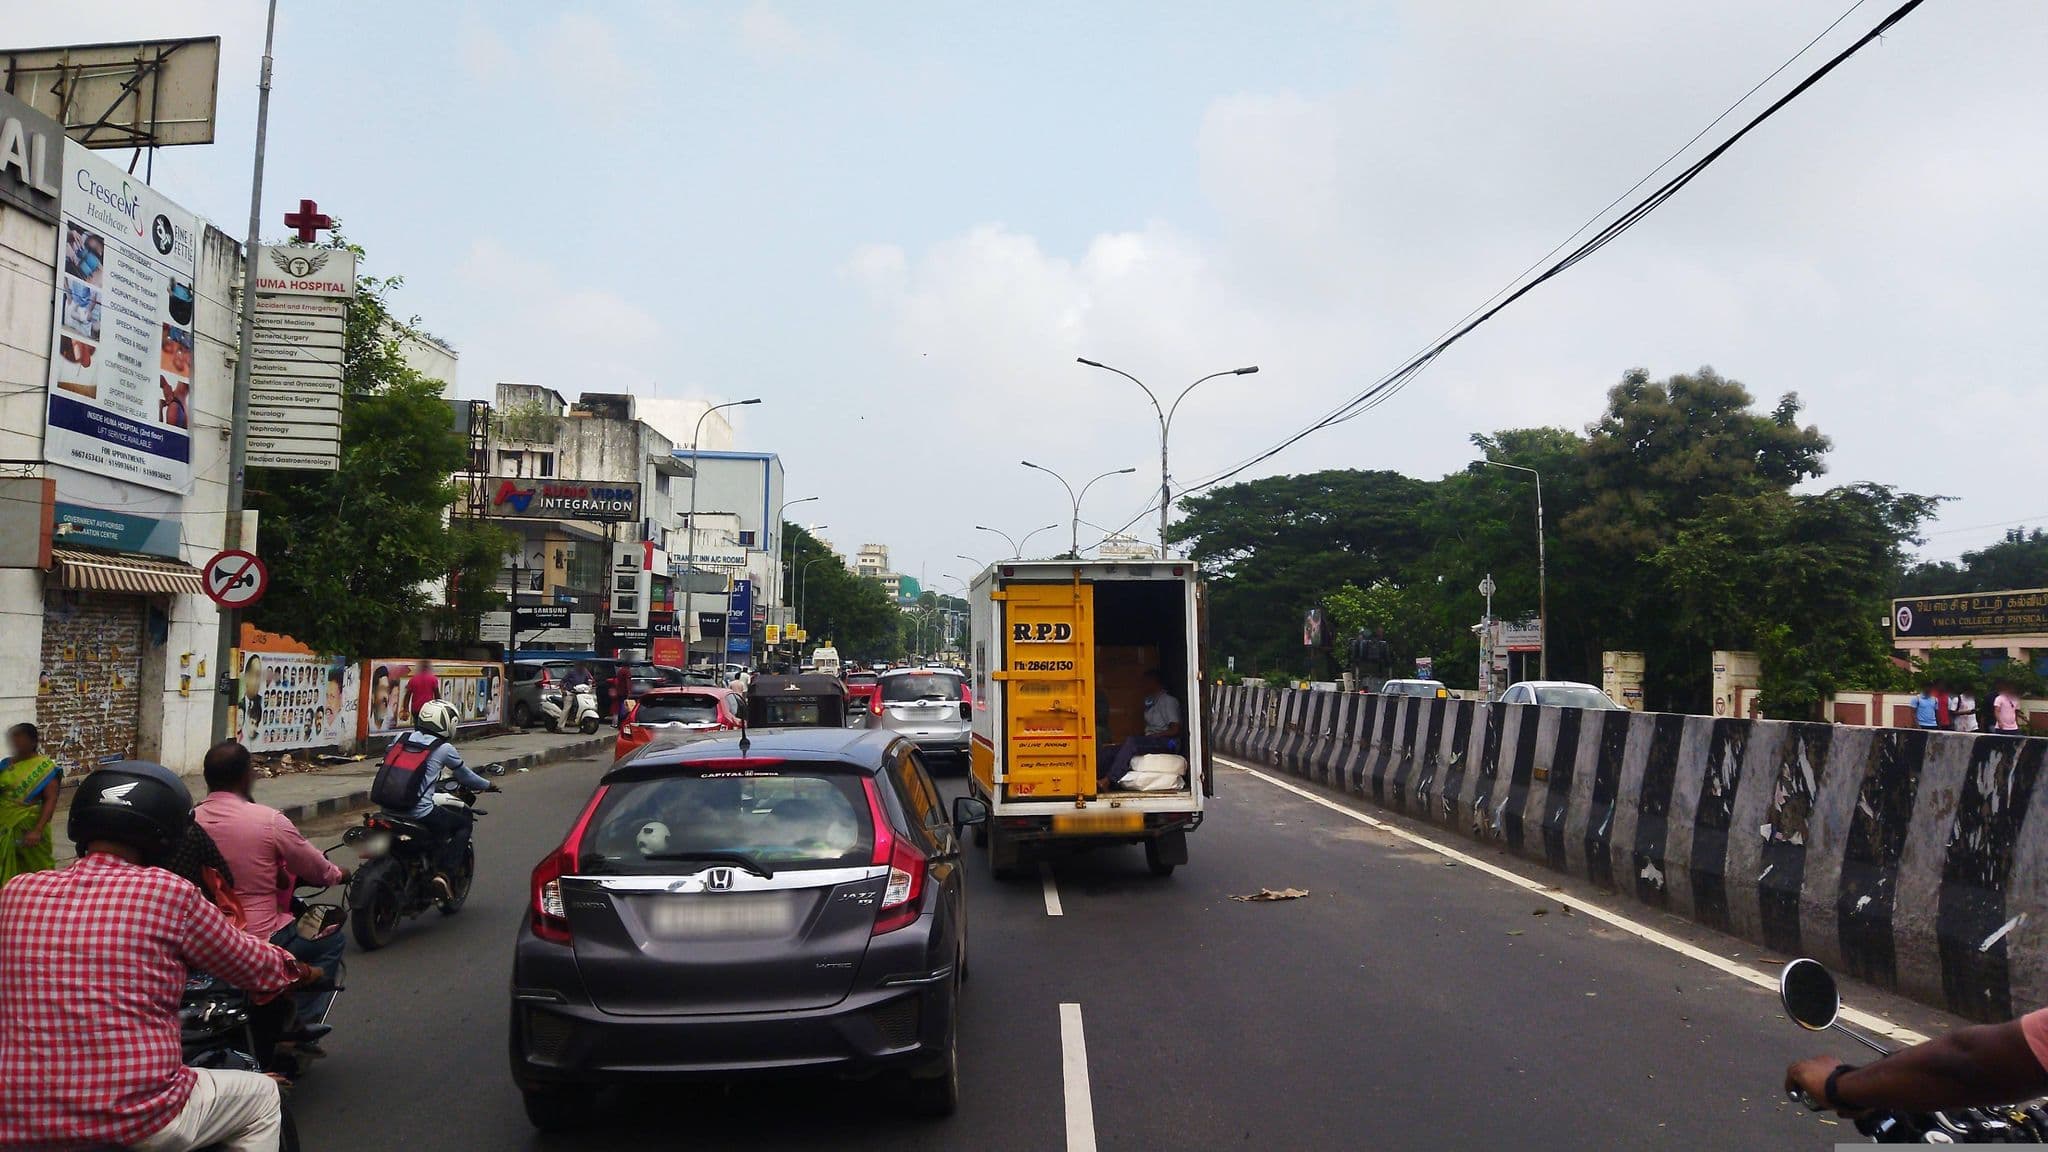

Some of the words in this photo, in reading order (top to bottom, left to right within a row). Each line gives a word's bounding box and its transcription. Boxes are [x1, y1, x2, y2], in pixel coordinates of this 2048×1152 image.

[0, 118, 59, 199] AL
[87, 202, 129, 235] Healthcare
[175, 224, 188, 244] FINE
[174, 240, 193, 263] FETTLE
[136, 269, 153, 282] THERAPY
[140, 286, 158, 298] THERAPY
[290, 280, 346, 293] HOSPITAL
[139, 300, 157, 312] THERAPY
[256, 301, 286, 309] Accident
[301, 304, 339, 313] Emergency
[255, 317, 283, 325] General
[116, 319, 133, 331] SPEECH
[133, 326, 150, 339] THERAPY
[114, 333, 132, 347] FITNESS
[283, 334, 309, 342] Surgery
[253, 347, 298, 356] Pulmonology
[134, 370, 151, 383] THERAPY
[295, 380, 336, 389] Gynaecology
[109, 387, 125, 397] SPORTS
[251, 393, 294, 401] Orthopedics
[294, 395, 320, 403] Surgery
[104, 398, 116, 408] DEEP
[250, 410, 285, 418] Neurology
[86, 410, 104, 423] INSIDE
[117, 421, 139, 435] HOSPITAL
[249, 425, 289, 433] Nephrology
[97, 426, 107, 434] LIFT
[107, 429, 127, 442] SERVICE
[127, 435, 152, 448] AVAILABLE
[248, 440, 275, 448] Urology
[101, 446, 111, 456] FOR
[247, 455, 274, 463] Medical
[275, 456, 332, 466] Gastroenterology
[542, 485, 589, 499] AUDIO
[591, 487, 633, 500] VIDEO
[540, 498, 633, 512] INTEGRATION
[62, 514, 96, 526] GOVERNMENT
[95, 520, 125, 531] AUTHORISED
[100, 531, 119, 540] CENTRE
[673, 554, 698, 562] TRANIT
[711, 556, 721, 564] A/C
[722, 556, 745, 564] ROOMS
[1932, 618, 1957, 626] YMCA
[1959, 616, 1993, 625] COLLEGE
[1994, 616, 2004, 624] OF
[2007, 614, 2048, 623] PHYSICAL
[837, 891, 877, 902] JAZZ
